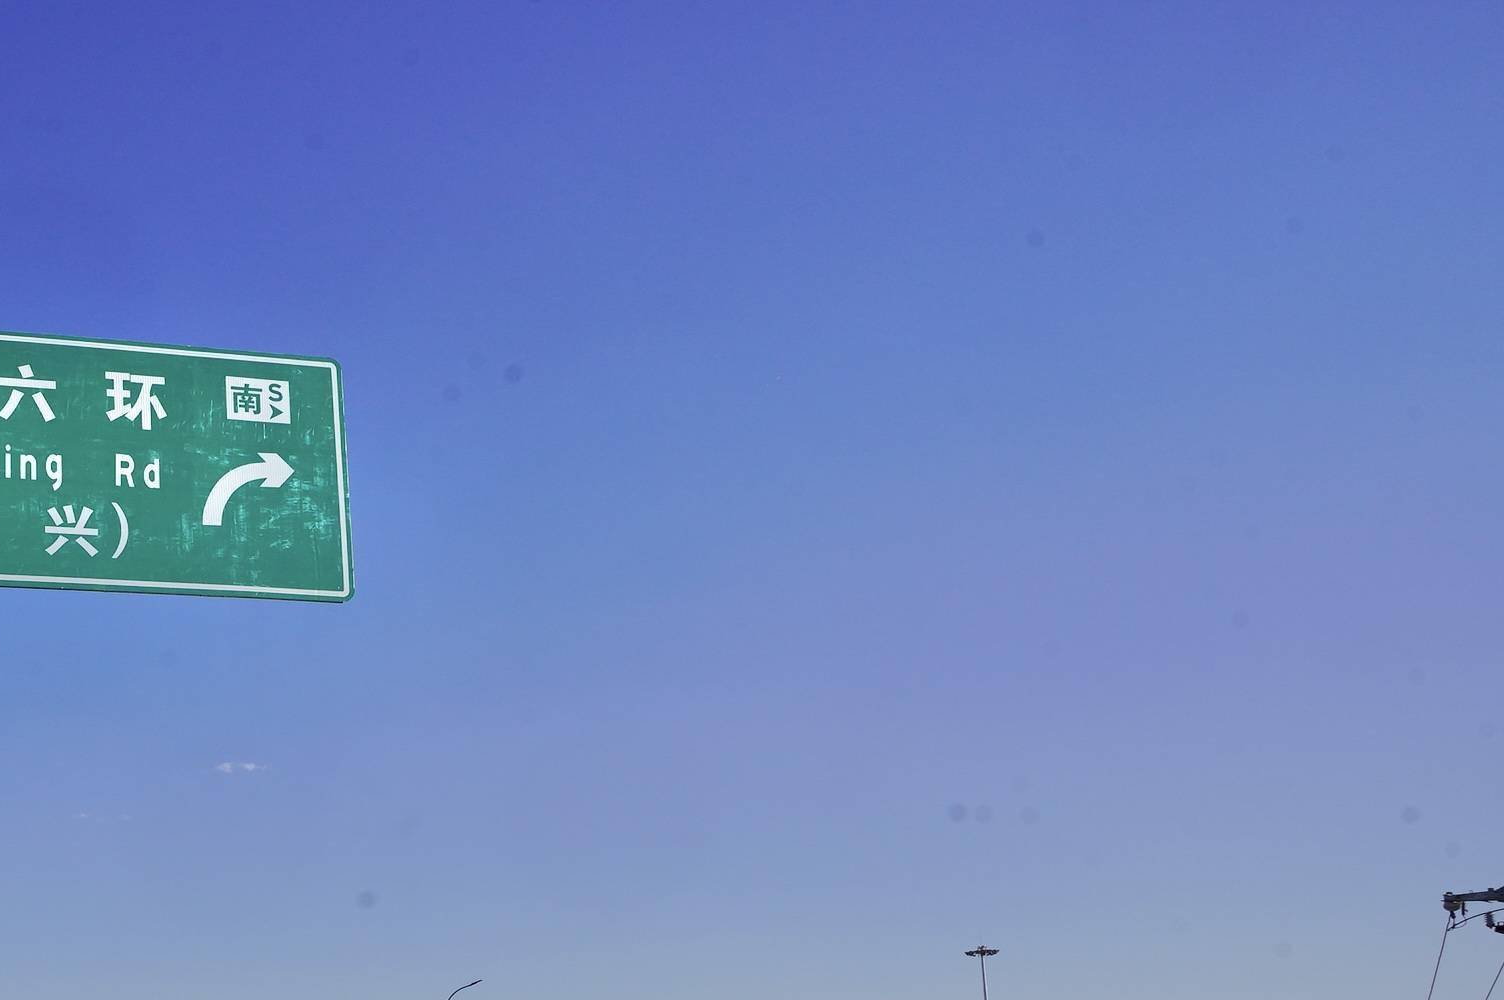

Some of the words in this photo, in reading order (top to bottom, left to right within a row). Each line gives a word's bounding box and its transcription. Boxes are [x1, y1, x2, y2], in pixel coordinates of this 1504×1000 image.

[231, 384, 263, 415] 南
[268, 383, 284, 402] S
[115, 454, 161, 489] Rd
